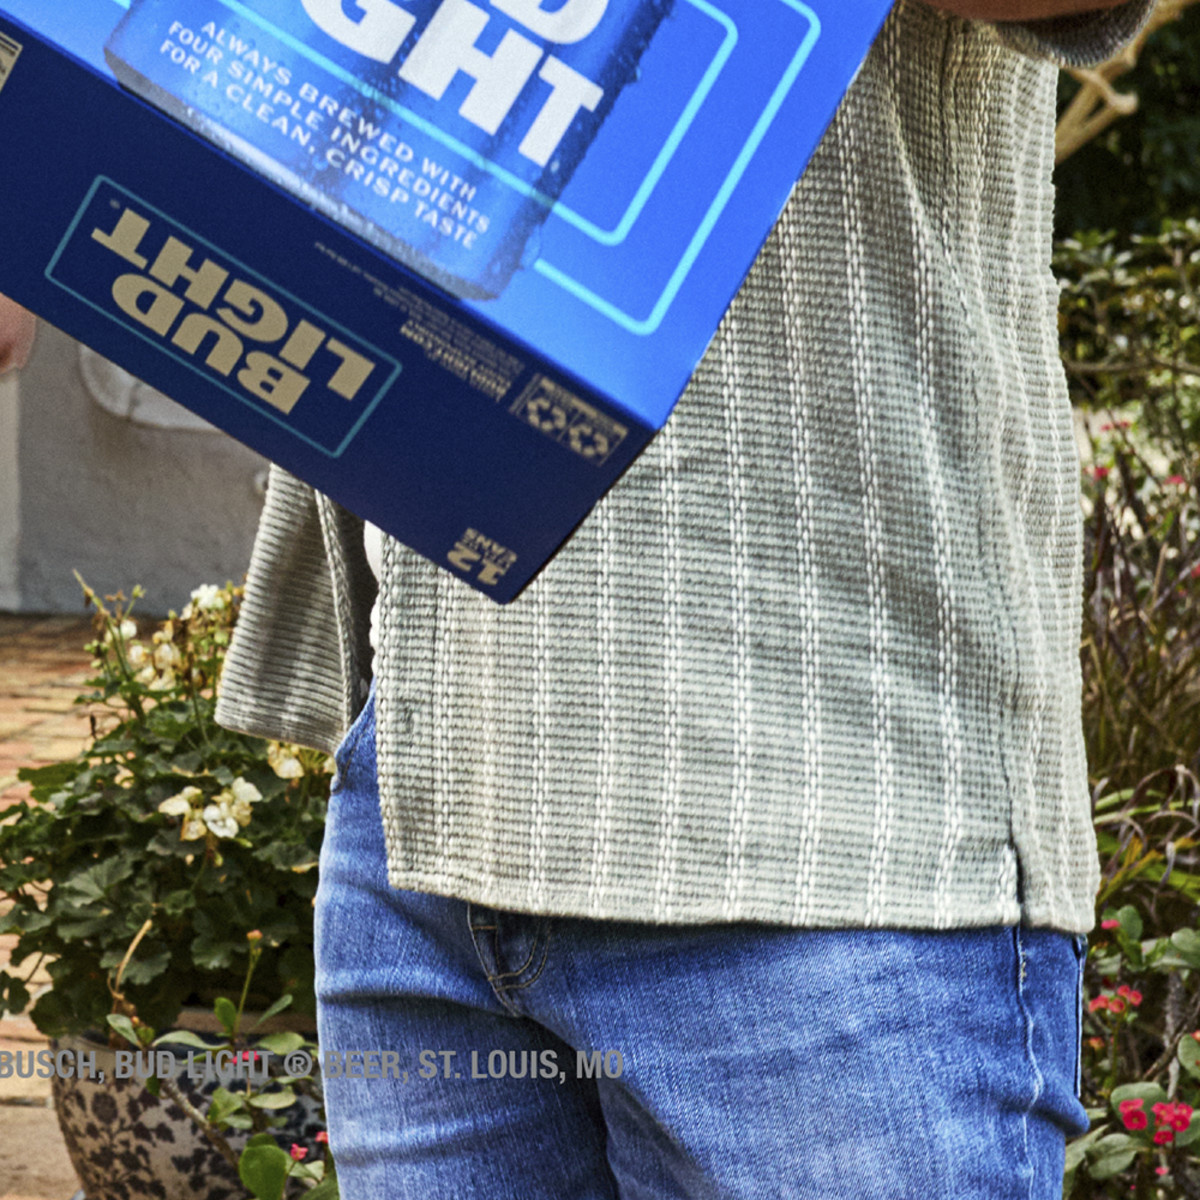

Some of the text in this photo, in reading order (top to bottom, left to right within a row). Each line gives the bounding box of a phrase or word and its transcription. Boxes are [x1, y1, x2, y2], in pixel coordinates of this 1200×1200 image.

[159, 39, 478, 250] FOR A CLEAN, CRISP TASTE
[167, 20, 491, 234] FOUR SIMPLE INGREDIENTS
[200, 18, 478, 203] ALWAYS BREWED WITH
[91, 209, 375, 400] LIGHT
[111, 273, 310, 415] BUD
[446, 544, 506, 586] 12
